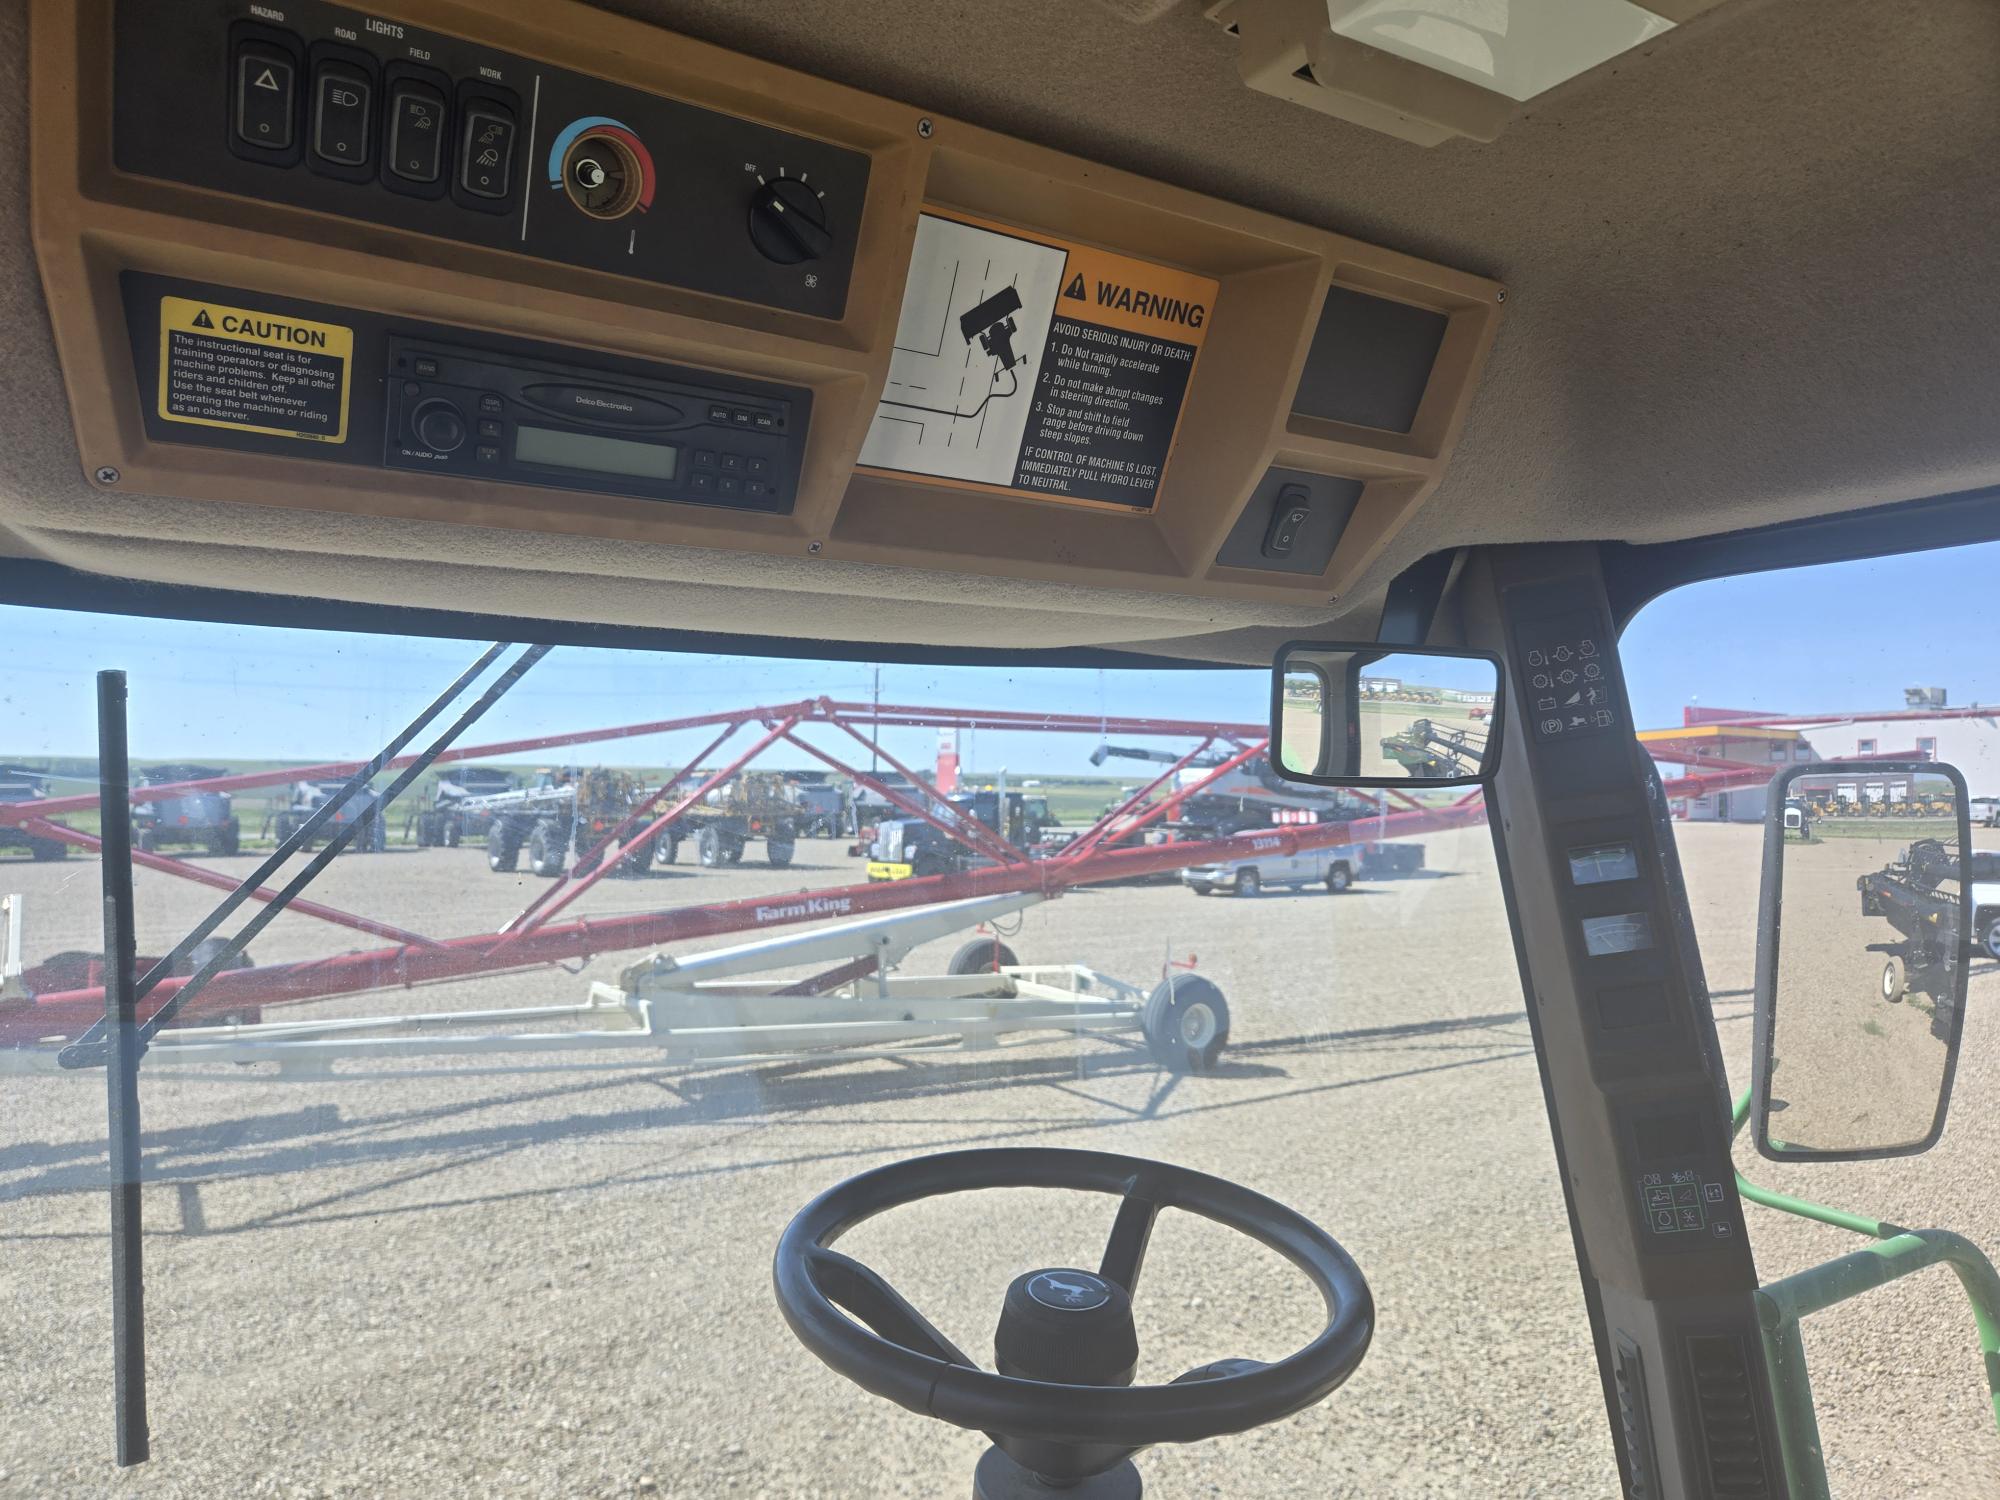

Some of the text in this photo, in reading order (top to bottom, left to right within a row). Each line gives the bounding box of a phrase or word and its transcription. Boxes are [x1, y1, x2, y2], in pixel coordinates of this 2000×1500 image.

[250, 5, 285, 22] HAZARD
[334, 27, 357, 41] ROAD
[365, 18, 405, 39] LIGHTS
[409, 47, 431, 61] FIELD
[479, 66, 502, 81] WORK
[744, 162, 757, 173] OFF
[1097, 280, 1205, 328] WARNING
[222, 315, 326, 348] CAUTION
[1052, 321, 1080, 336] AVOID
[1081, 328, 1118, 345] SERIOUS
[1119, 336, 1150, 352] INJURY
[1150, 343, 1163, 355] OR
[174, 333, 311, 364] The instructional seat is for
[1051, 341, 1159, 373] 1. Do Not rapidly accelerate
[173, 346, 213, 361] training
[216, 354, 265, 367] operators
[280, 363, 334, 380] diagnosing
[173, 358, 335, 389] machine problems. Keep all other
[1057, 357, 1111, 377] while turning.
[173, 368, 287, 393] riders and children off.
[173, 379, 307, 406] Use the seat belt whenever
[1042, 372, 1163, 405] 2. Do not make abrupt changes
[172, 392, 327, 422] operating the machine or riding
[576, 396, 633, 412] Delco Electronics
[1049, 386, 1129, 410] in steering direction.
[172, 403, 249, 420] as an observer.
[712, 411, 727, 419] AUTO
[757, 418, 771, 426] SCAN
[1035, 401, 1130, 427] 3. Stop and shift to field
[1039, 427, 1091, 444] steep slopes.
[1042, 417, 1143, 441] range before driving down
[1024, 445, 1033, 456] IF
[1034, 447, 1073, 463] CONTROL
[1075, 454, 1087, 464] OF
[1087, 456, 1125, 470] MACHINE
[1125, 462, 1134, 472] IS
[1018, 473, 1070, 490] TO NEUTRAL.
[1021, 459, 1154, 489] IMMEDIATELY PULL HYDRO LEVER
[756, 897, 851, 921] Farm King
